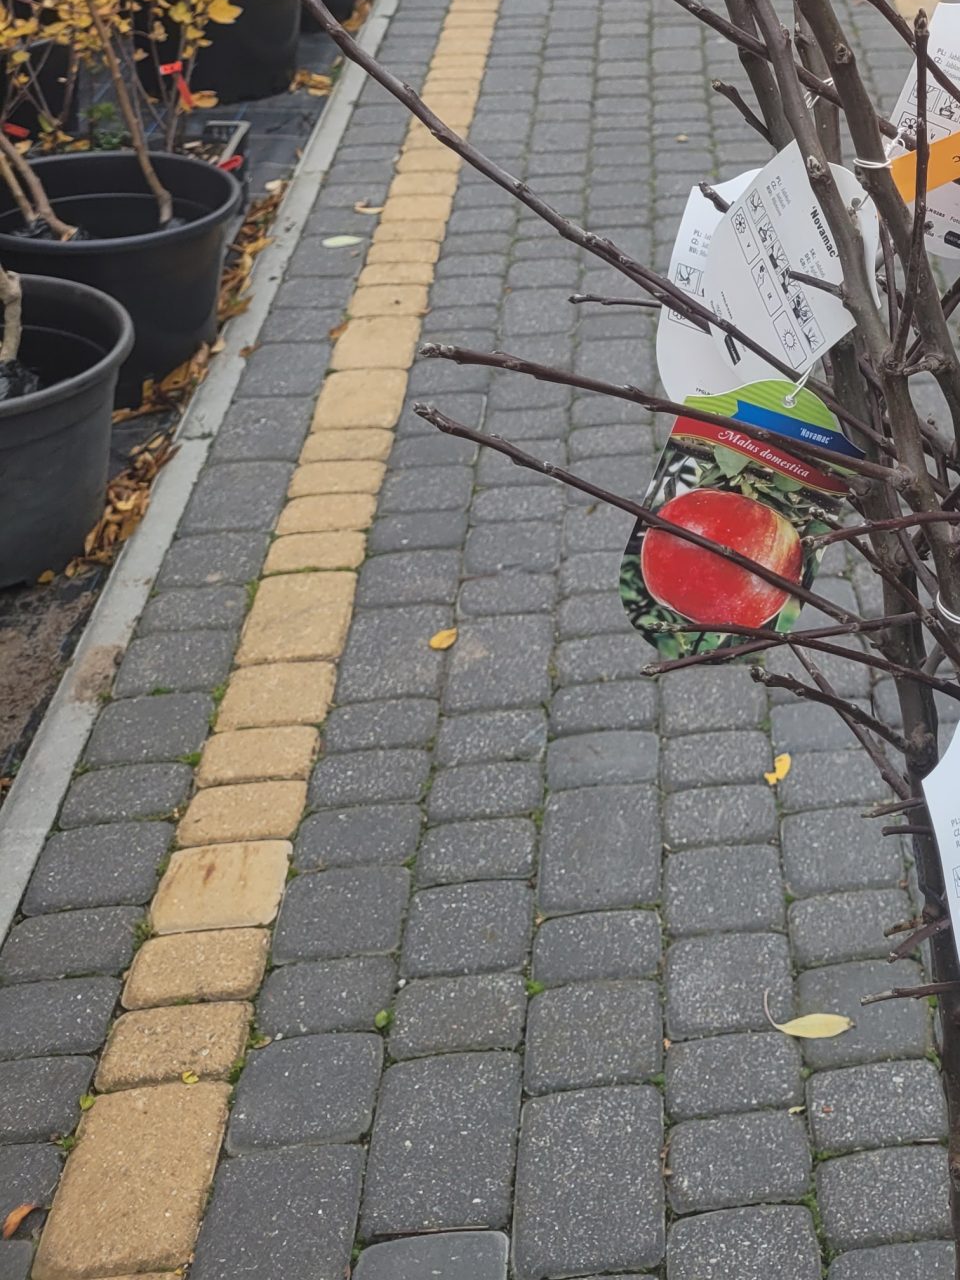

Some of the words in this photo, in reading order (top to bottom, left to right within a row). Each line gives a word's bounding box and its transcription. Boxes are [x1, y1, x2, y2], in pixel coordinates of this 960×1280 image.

[811, 206, 838, 258] 'Novamac'
[718, 430, 759, 453] Malus
[758, 449, 810, 478] domestica
